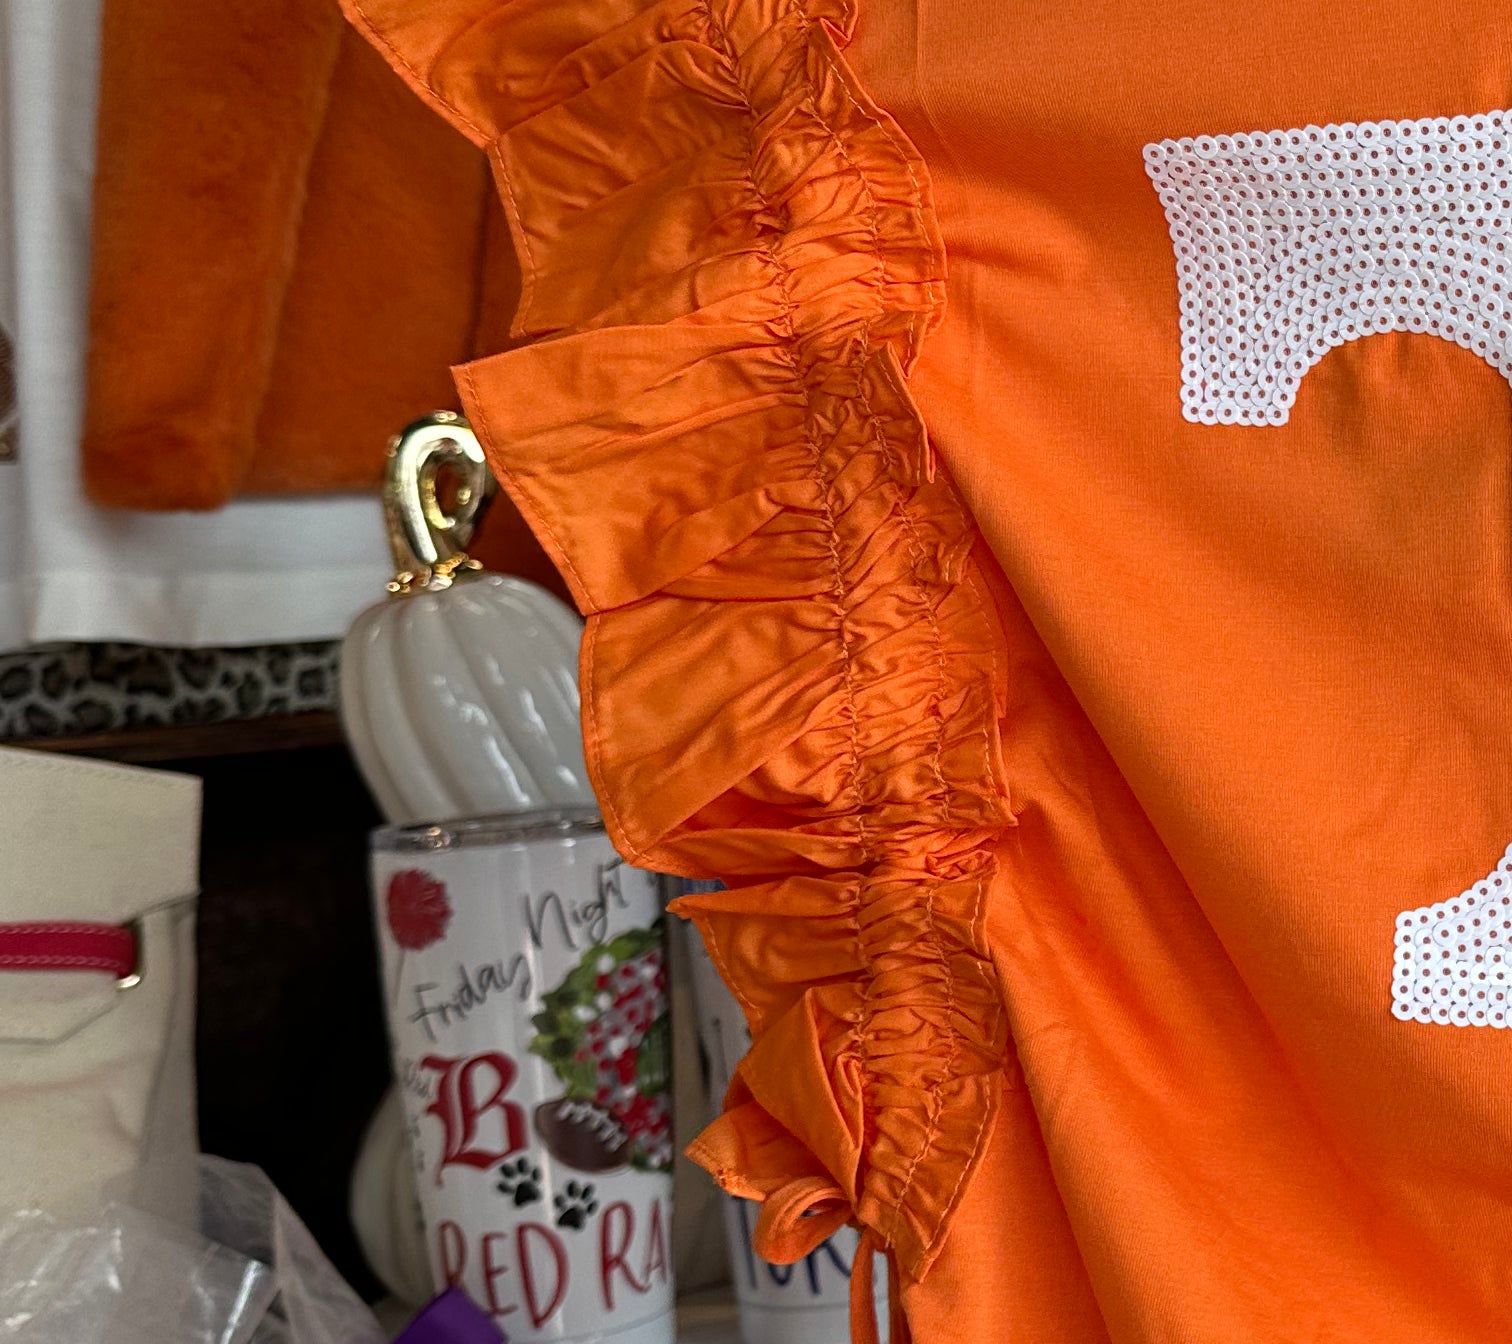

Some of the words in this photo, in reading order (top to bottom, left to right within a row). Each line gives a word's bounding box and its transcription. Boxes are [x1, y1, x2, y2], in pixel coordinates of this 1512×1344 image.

[408, 954, 531, 1043] Friday
[419, 1050, 529, 1187] B
[438, 1220, 570, 1330] RED
